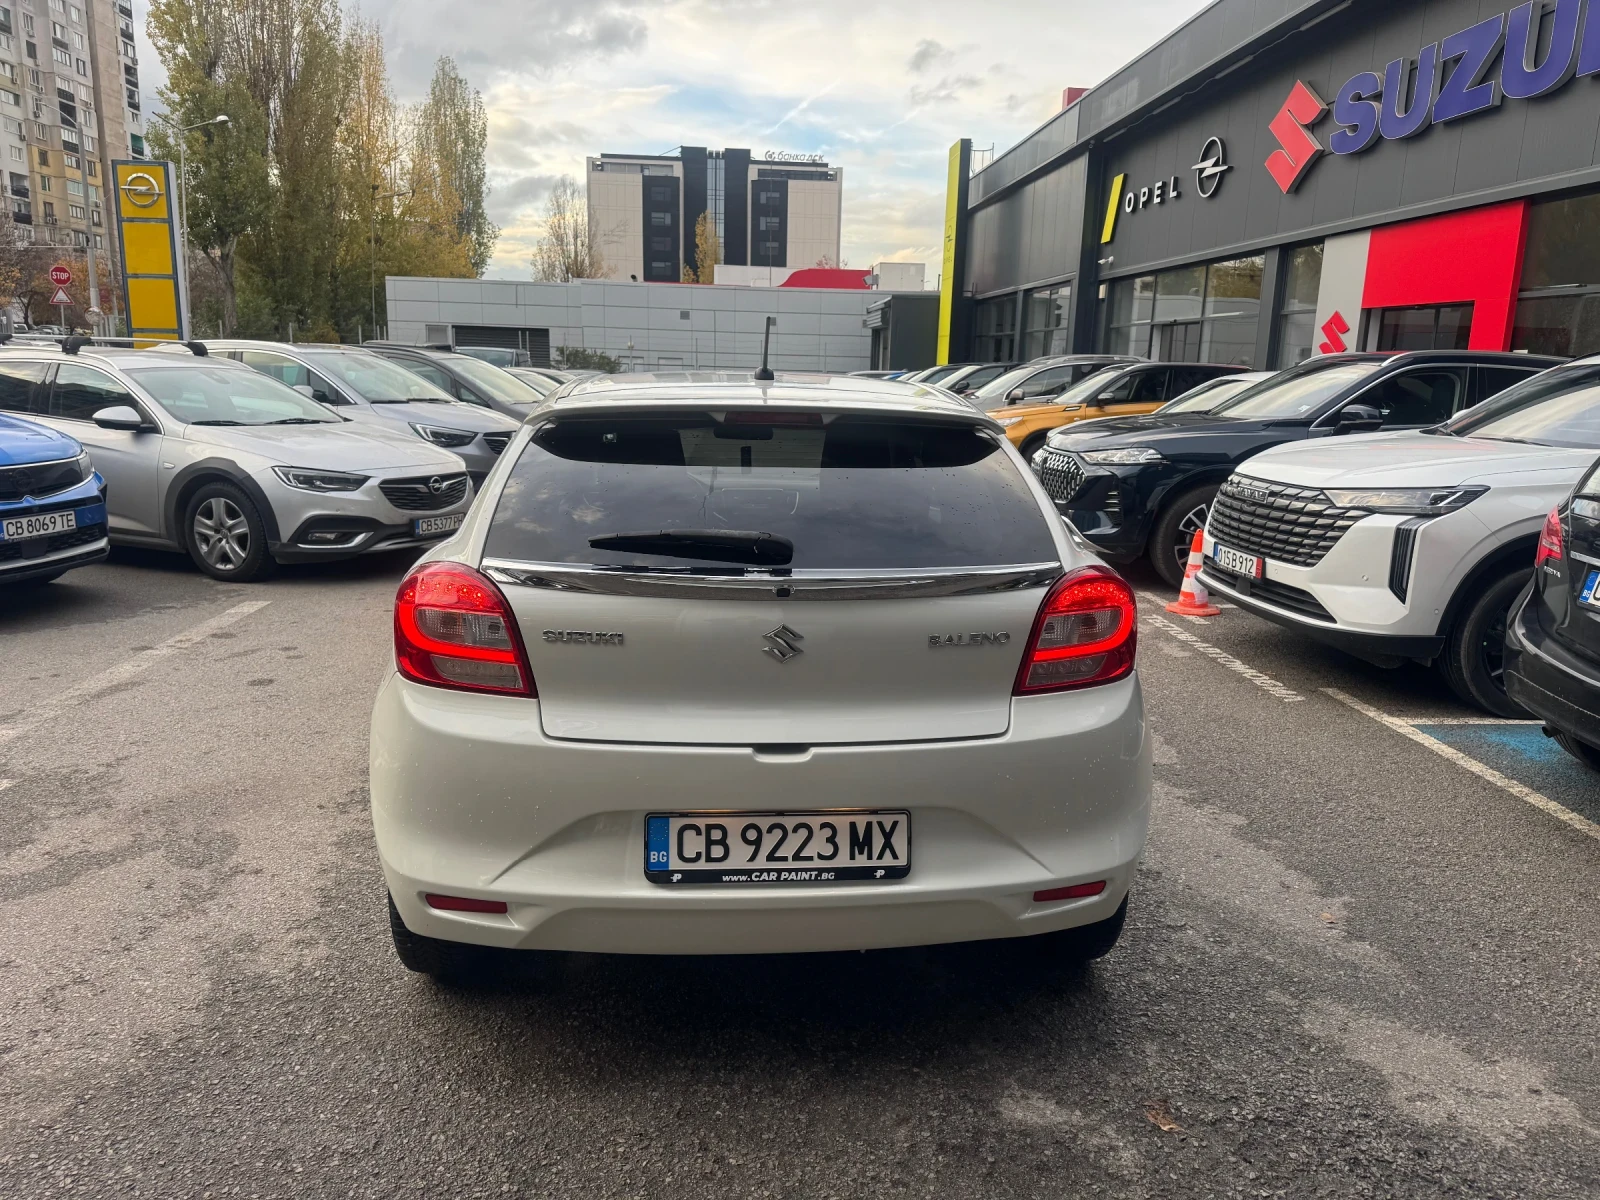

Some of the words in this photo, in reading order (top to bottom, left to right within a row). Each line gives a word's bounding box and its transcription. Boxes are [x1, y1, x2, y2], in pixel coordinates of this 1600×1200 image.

[1125, 176, 1178, 213] OPEL
[52, 271, 70, 280] STOP
[6, 521, 24, 537] CB
[27, 516, 57, 534] 8069
[58, 513, 75, 529] TE
[421, 520, 433, 532] CB
[433, 517, 453, 531] 5377
[542, 628, 624, 646] SUZUKI
[928, 631, 1011, 648] BALENO
[677, 823, 730, 863] CB
[740, 822, 840, 862] 9223
[848, 820, 900, 861] MX
[650, 851, 668, 863] BG
